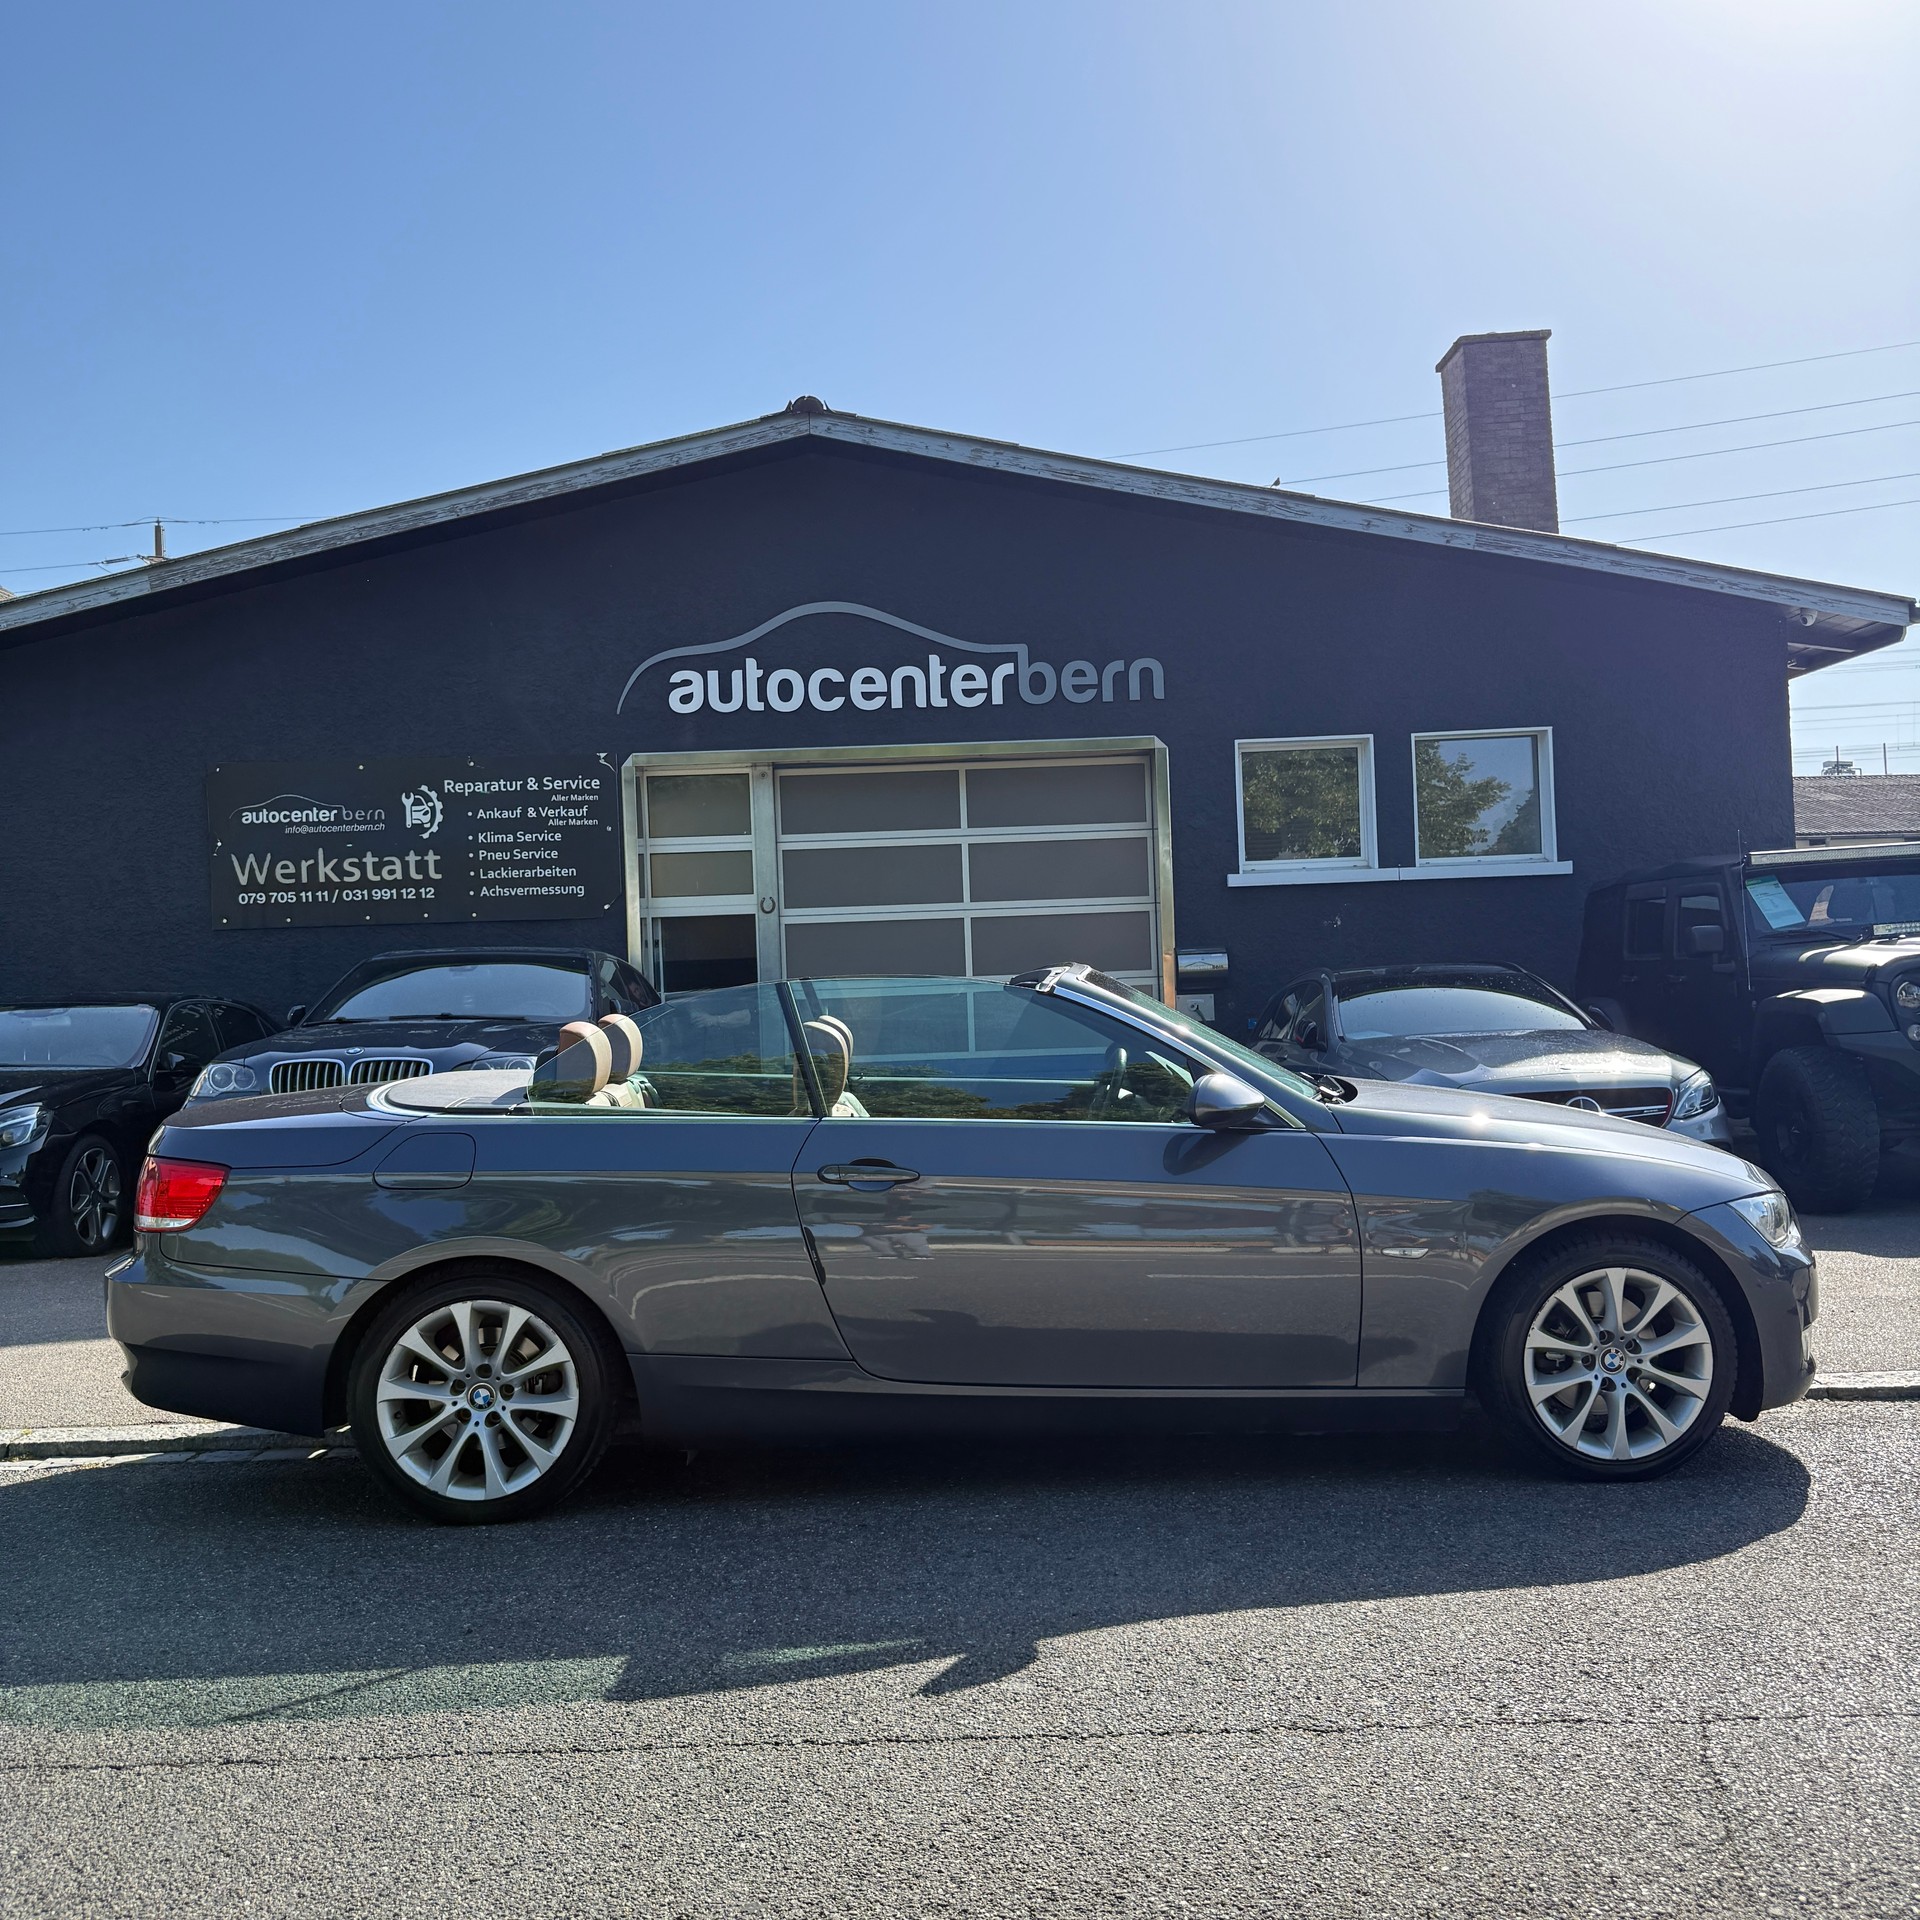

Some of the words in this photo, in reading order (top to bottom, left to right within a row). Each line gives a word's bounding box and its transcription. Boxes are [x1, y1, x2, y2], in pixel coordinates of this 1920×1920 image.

[443, 778, 523, 796] Reparatur
[526, 777, 539, 791] &
[543, 775, 600, 790] Service
[551, 794, 570, 802] Aller
[570, 793, 599, 802] Marken
[476, 807, 522, 819] Ankauf
[527, 807, 537, 818] &
[539, 805, 589, 818] Verkauf
[284, 823, 386, 835] info@autocenterbern.ch
[568, 818, 599, 826] Marken
[478, 831, 513, 843] Klima
[516, 830, 562, 842] Service
[479, 849, 511, 861] Pneu
[513, 847, 559, 859] Service
[230, 847, 443, 886] Werkstatt
[480, 865, 577, 879] Lackierarbeiten
[238, 892, 266, 905] 079
[268, 891, 297, 903] 705
[300, 891, 313, 902] 11
[315, 890, 329, 902] 11
[342, 889, 369, 901] 031
[371, 888, 397, 900] 991
[400, 887, 416, 899] 12
[418, 886, 436, 898] 12
[480, 884, 585, 897] Achsvermessung
